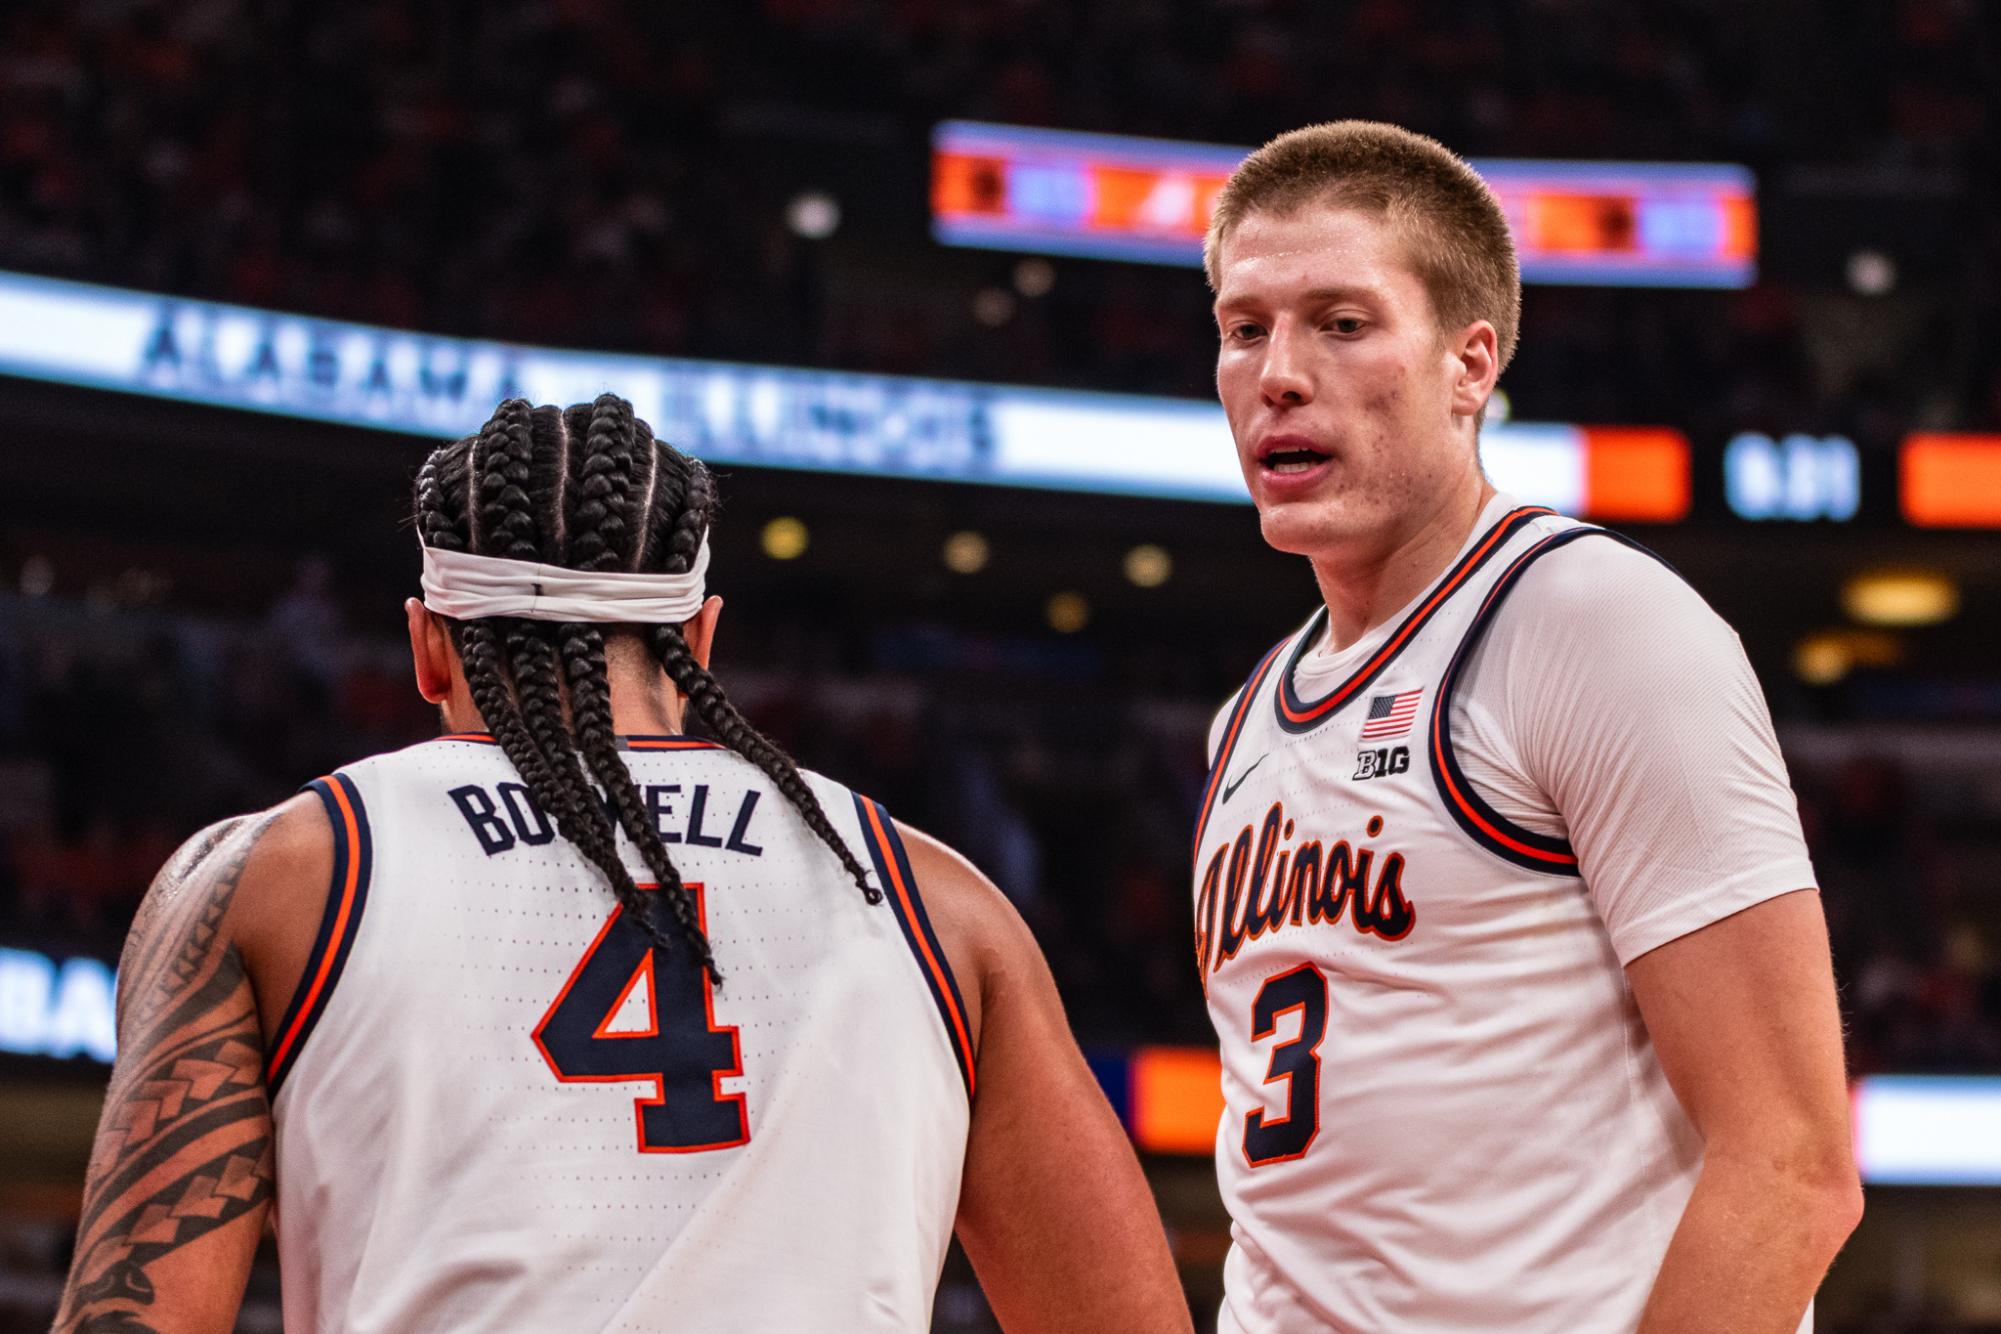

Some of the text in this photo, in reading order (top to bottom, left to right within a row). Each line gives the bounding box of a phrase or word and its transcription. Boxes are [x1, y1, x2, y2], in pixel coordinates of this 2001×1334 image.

[447, 782, 763, 857] BOELL
[1195, 801, 1416, 1000] Illinois
[531, 881, 751, 1154] 4
[1242, 961, 1329, 1168] 3
